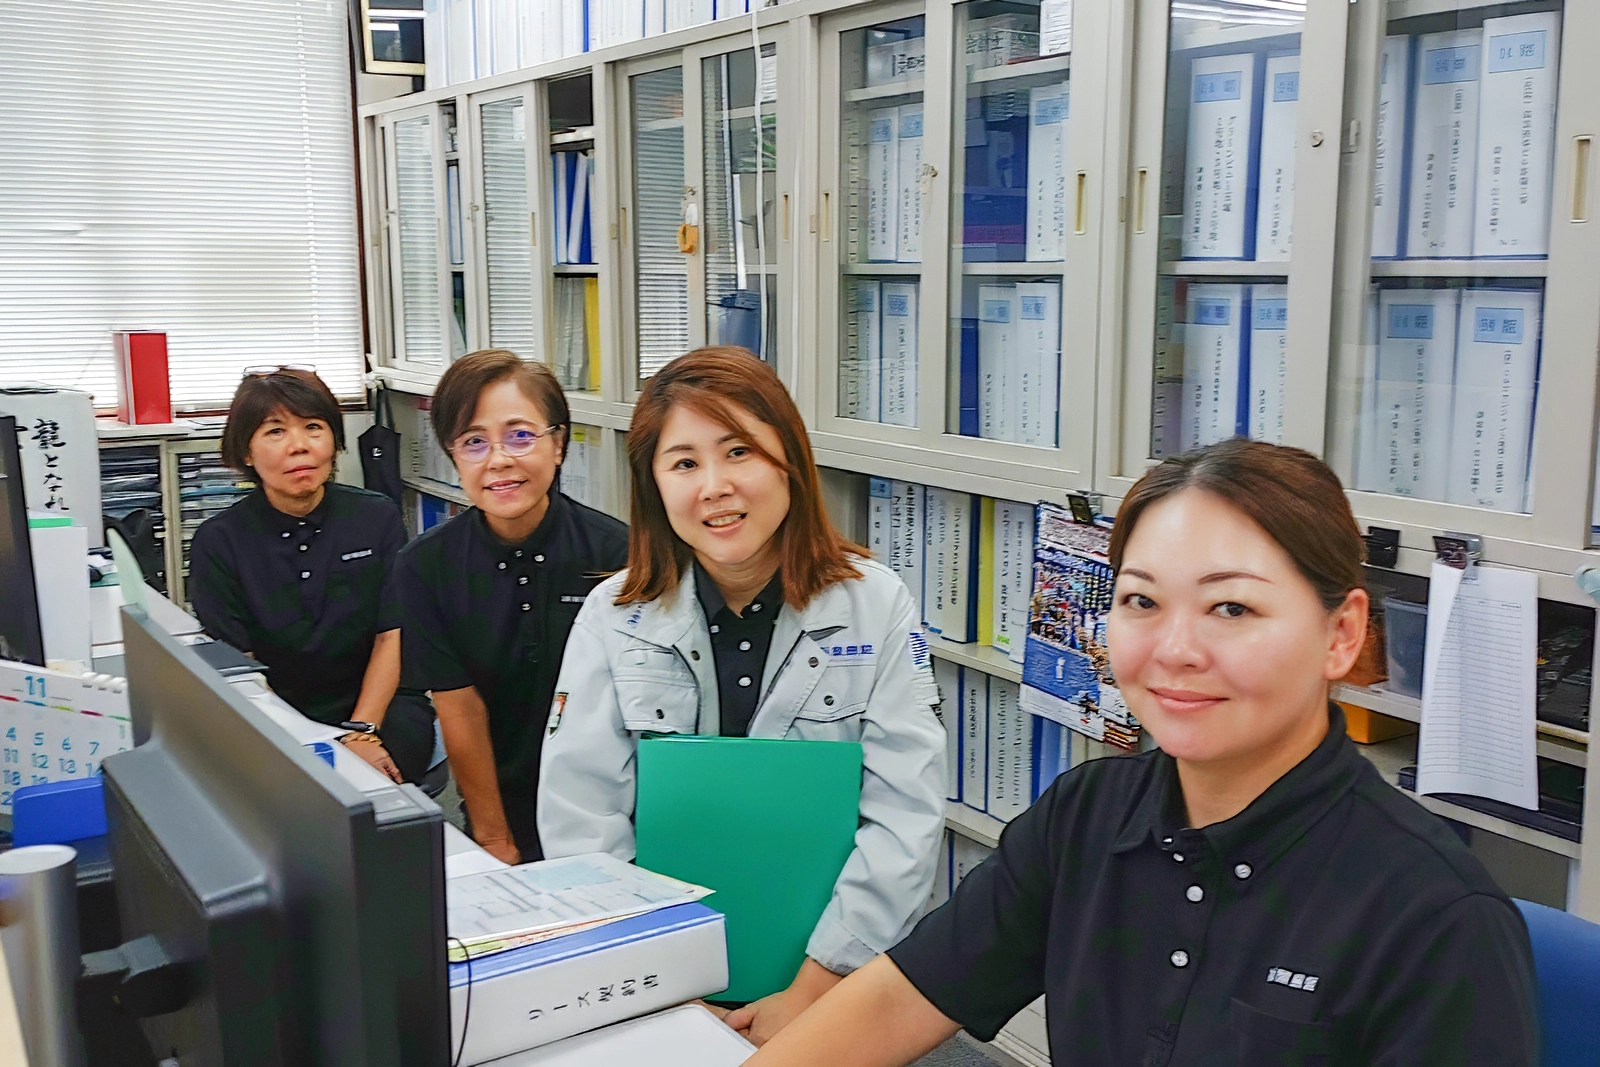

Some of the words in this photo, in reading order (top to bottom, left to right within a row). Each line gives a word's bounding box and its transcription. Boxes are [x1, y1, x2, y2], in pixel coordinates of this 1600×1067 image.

[25, 675, 46, 698] 11
[5, 727, 17, 741] 4
[33, 732, 45, 746] 5
[61, 737, 72, 751] 6
[88, 741, 101, 756] 7
[31, 752, 49, 769] 12
